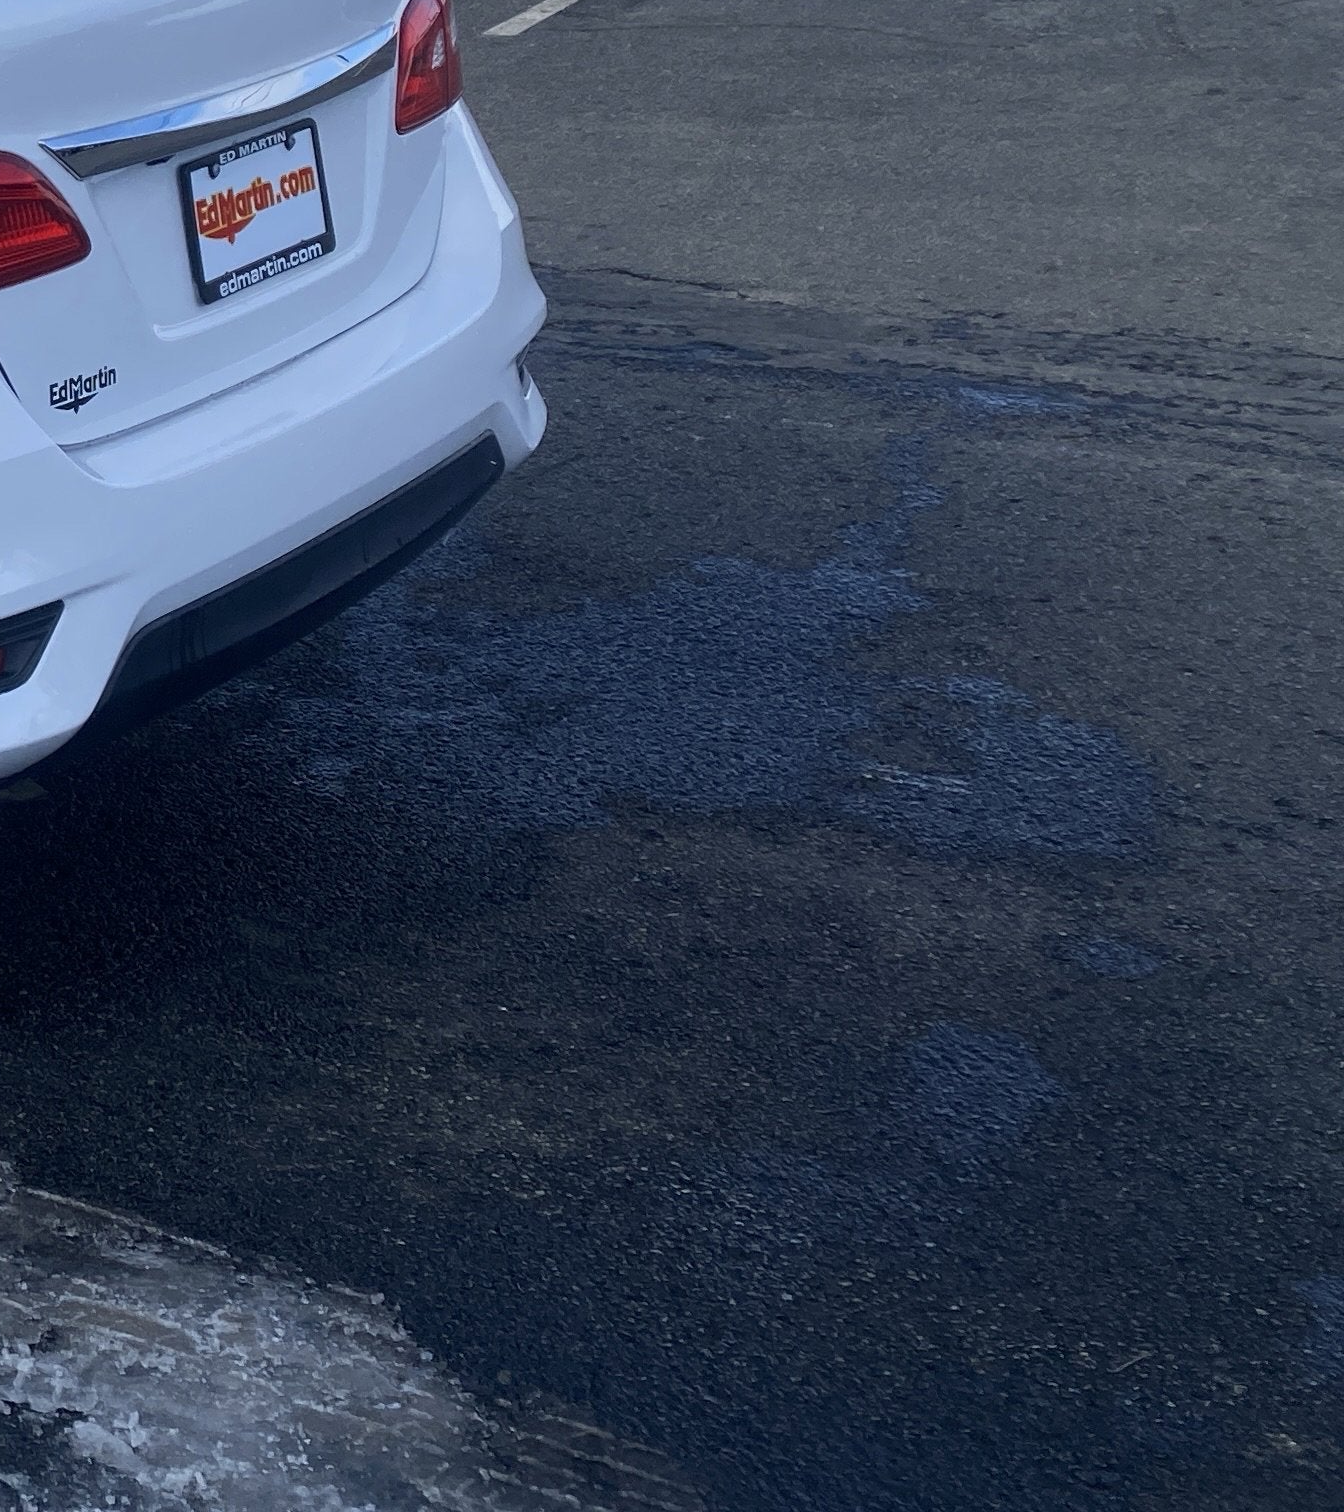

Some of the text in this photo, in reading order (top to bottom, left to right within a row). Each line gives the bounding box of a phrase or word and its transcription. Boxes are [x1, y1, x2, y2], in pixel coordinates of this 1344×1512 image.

[219, 131, 288, 166] ED MARTIN
[195, 165, 317, 243] EdMartin.com
[218, 241, 323, 298] edmartin.com
[48, 365, 118, 412] EdMartin
